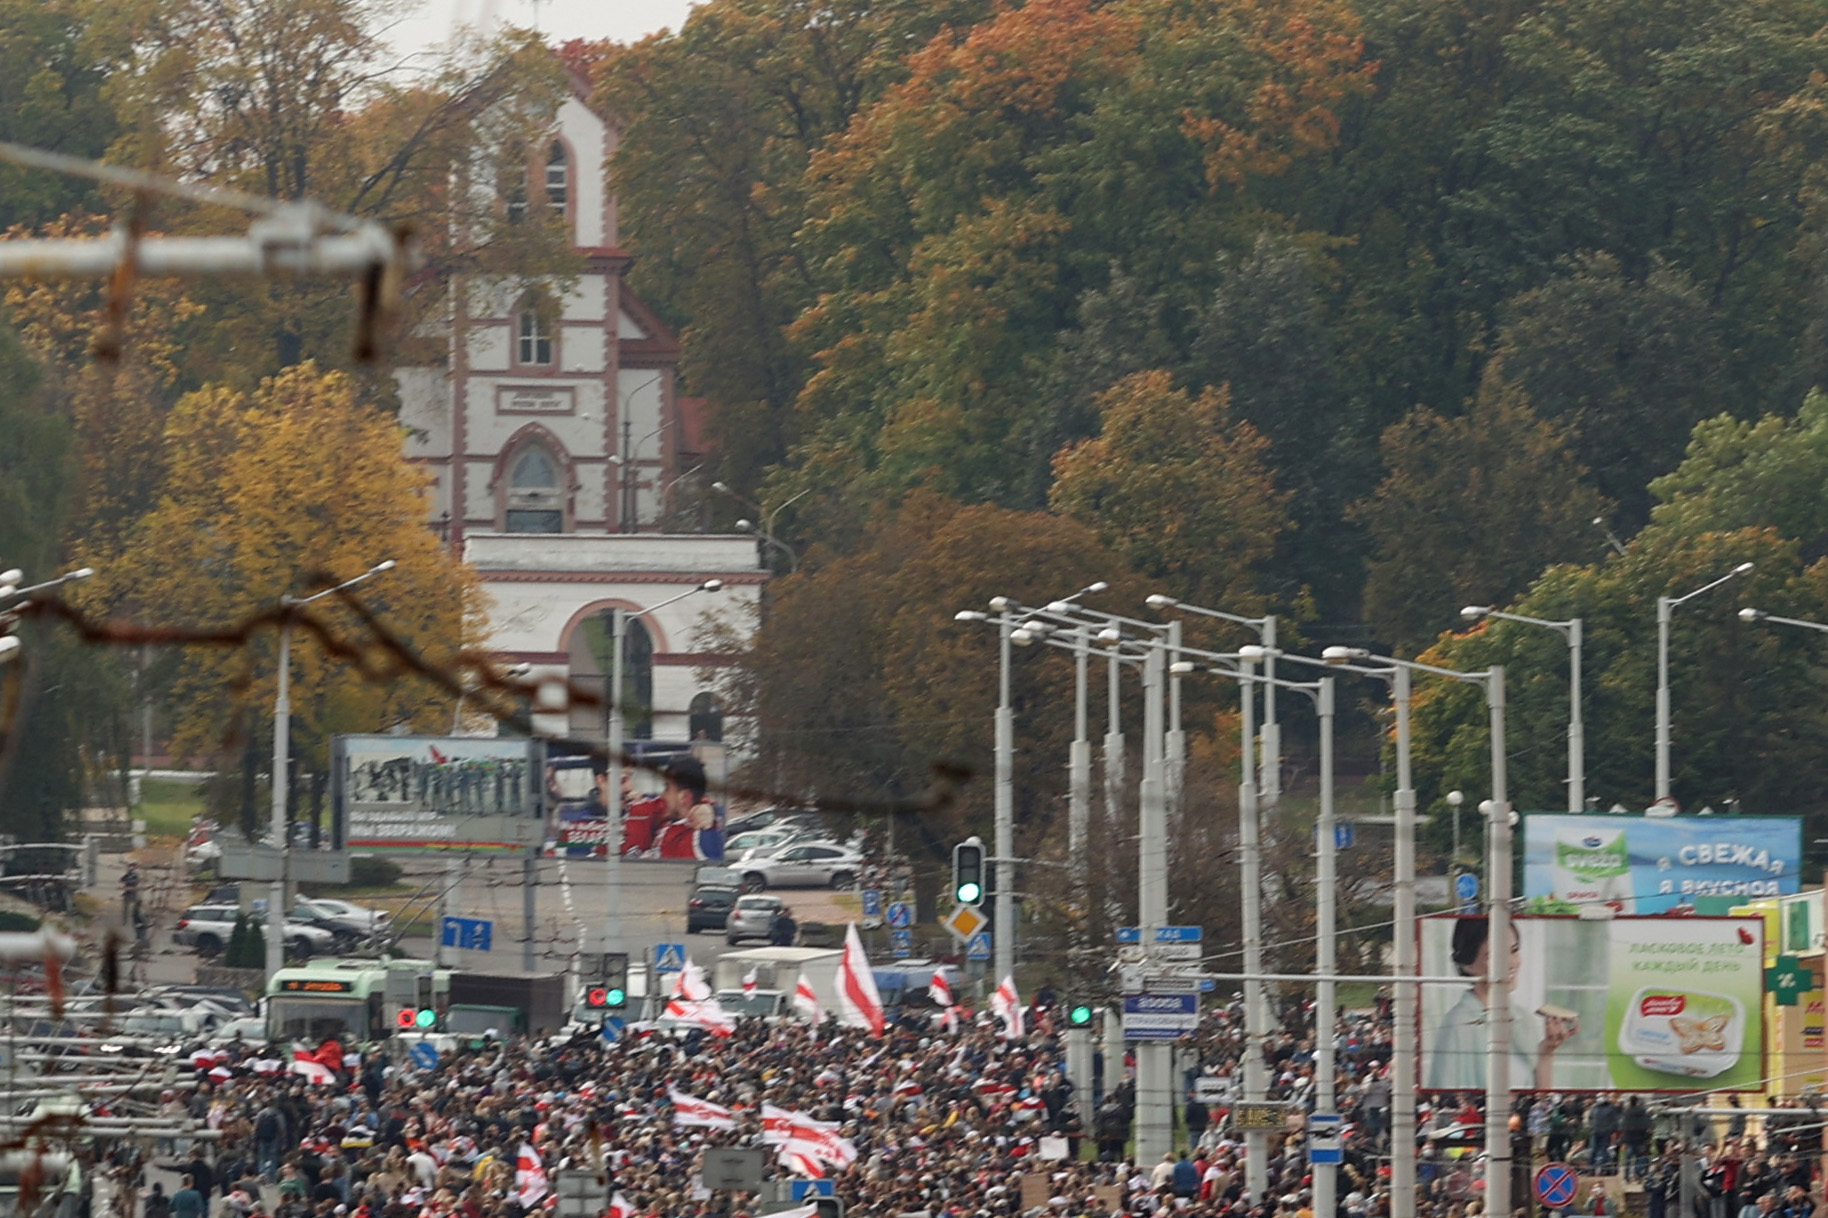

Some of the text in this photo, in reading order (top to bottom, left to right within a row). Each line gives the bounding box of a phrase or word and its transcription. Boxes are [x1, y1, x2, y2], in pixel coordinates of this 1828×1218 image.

[1628, 942, 1745, 955] ЛАСКОВОЕ ЛЕТО
[1631, 956, 1742, 974] КАЖДЫЙ ДЕНЬ
